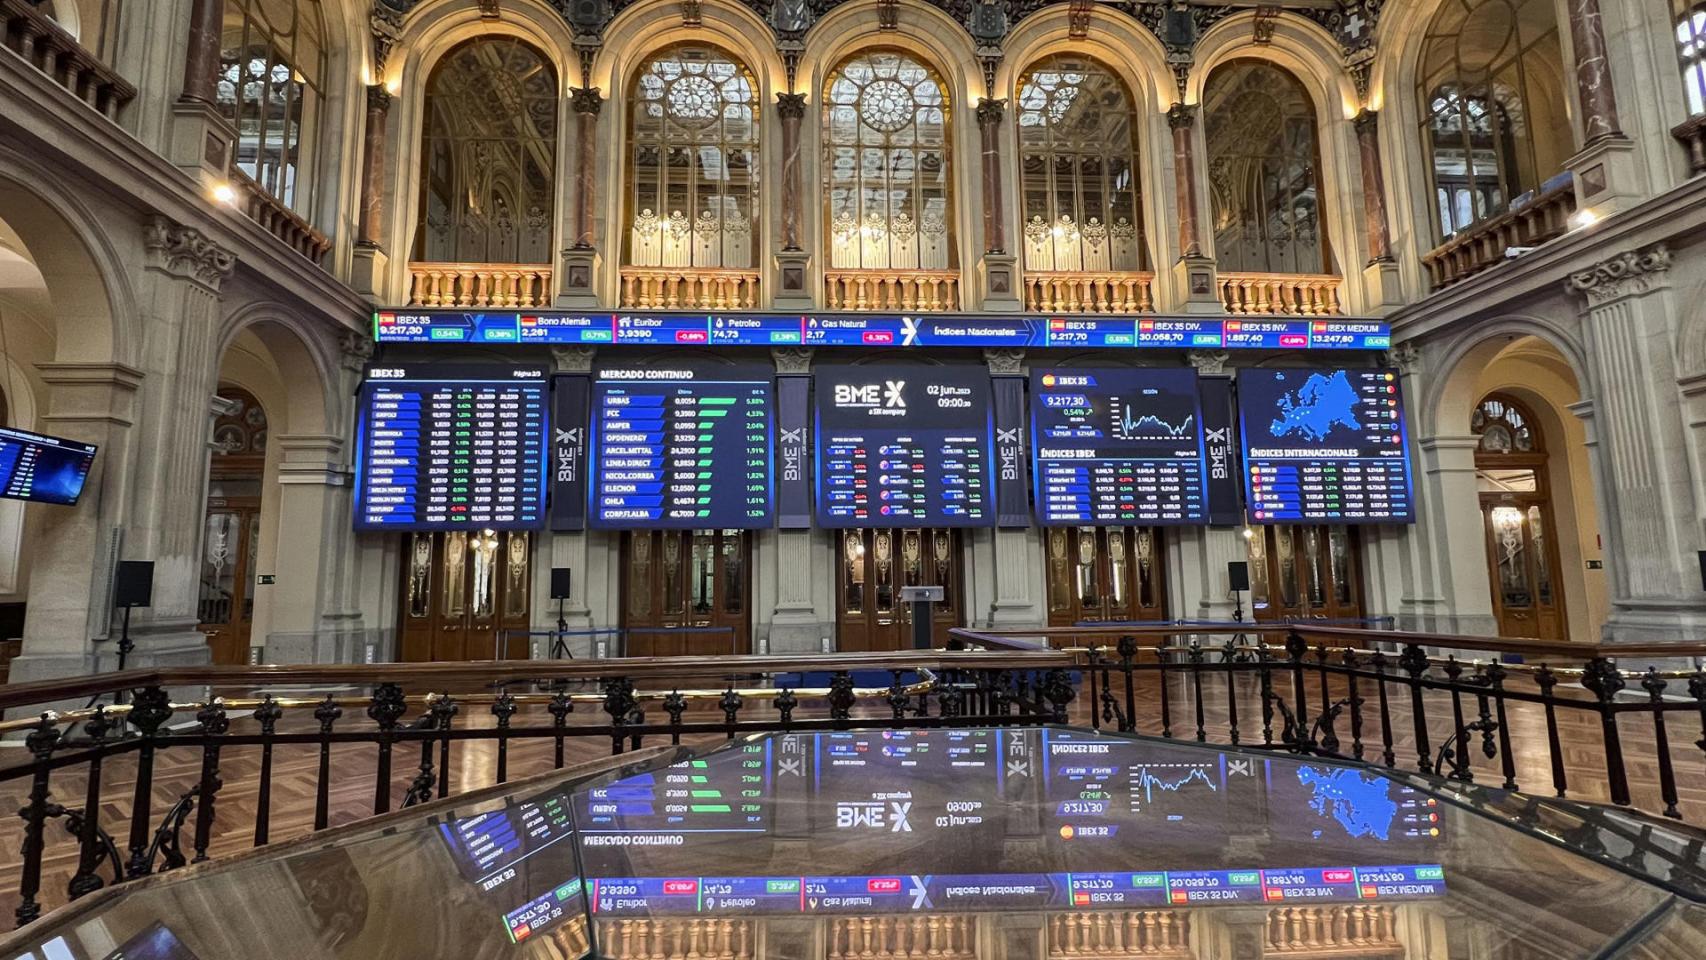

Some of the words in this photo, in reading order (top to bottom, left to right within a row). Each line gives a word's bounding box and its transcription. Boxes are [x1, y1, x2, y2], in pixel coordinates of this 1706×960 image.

[397, 317, 418, 325] IBEX
[420, 317, 430, 325] 35
[561, 317, 591, 325] Alemán
[634, 319, 662, 327] Euribor
[729, 319, 760, 327] Petroleo
[1185, 323, 1201, 331] DIV.
[1328, 324, 1345, 332] IBEX
[1347, 324, 1378, 332] MEDIUM
[618, 330, 651, 338] 3,9390
[713, 330, 738, 338] 74,73
[807, 331, 824, 339] 2,17
[934, 327, 965, 336] Índices
[968, 328, 1015, 336] Nacionales
[835, 385, 880, 402] BME
[927, 386, 938, 394] 02
[1041, 449, 1074, 457] ÍNDICES
[1251, 448, 1283, 457] ÍNDICES
[1285, 449, 1358, 457] INTERNACIONALES
[558, 448, 572, 481] BME
[785, 447, 797, 480] BME
[1001, 447, 1014, 479] BME
[1210, 446, 1224, 478] BME
